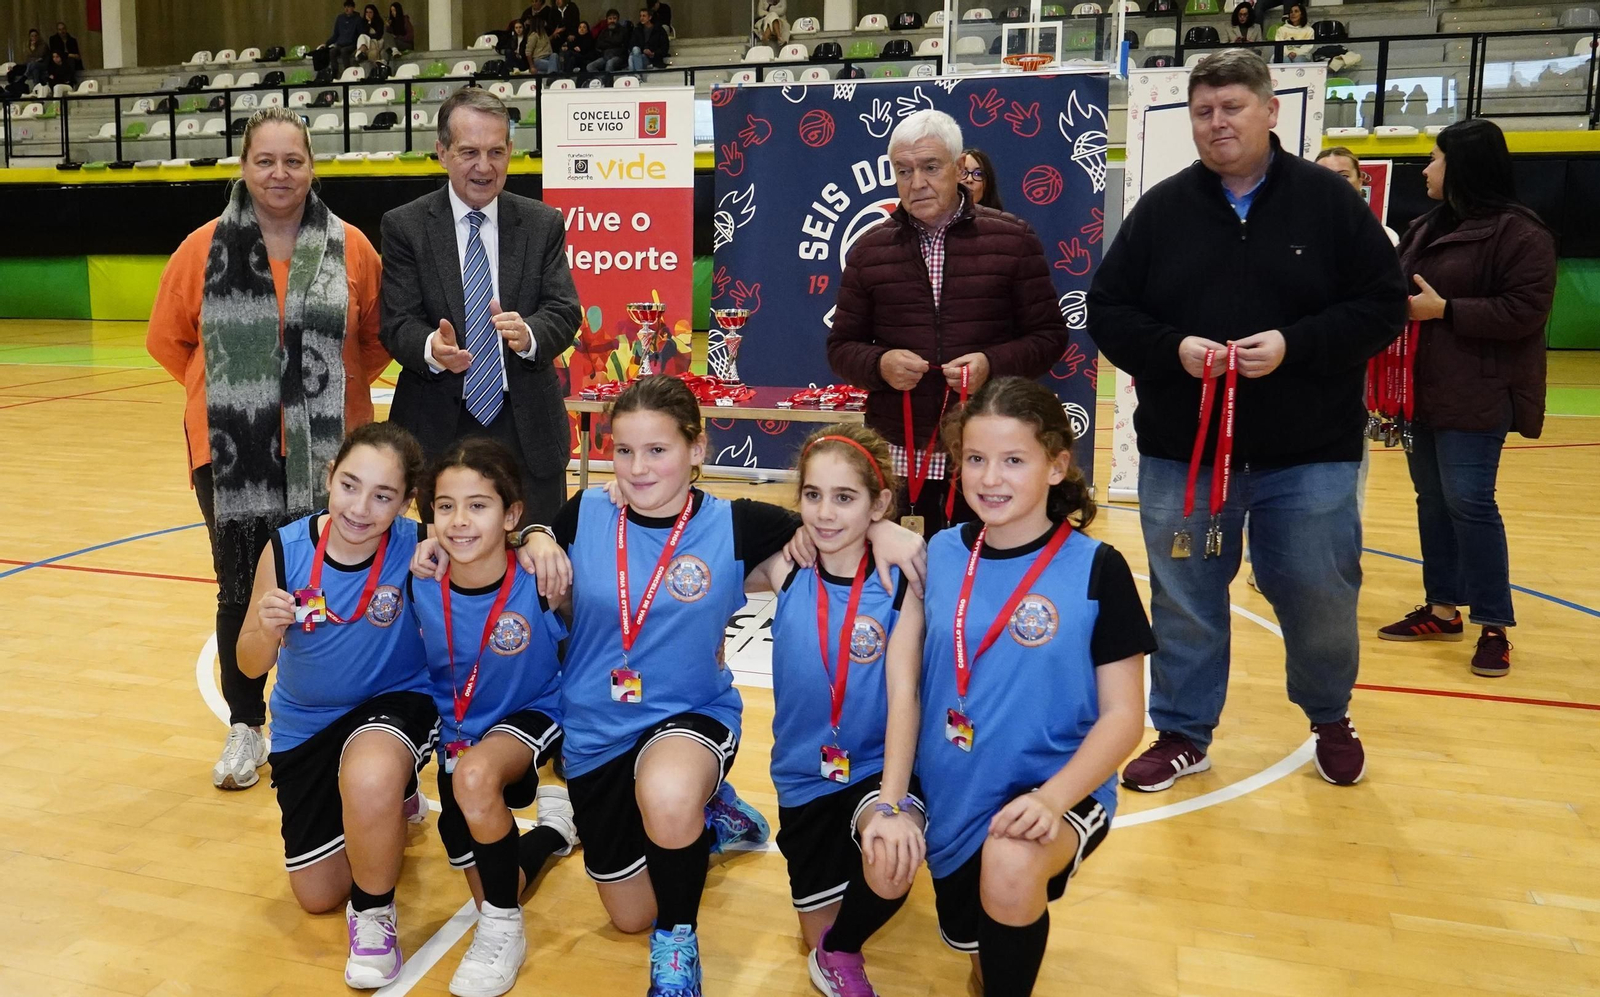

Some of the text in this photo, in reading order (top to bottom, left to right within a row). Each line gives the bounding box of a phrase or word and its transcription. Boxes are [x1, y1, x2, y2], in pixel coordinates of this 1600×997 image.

[573, 111, 630, 121] CONCELLO
[580, 122, 623, 132] DE VIGO
[596, 153, 666, 180] vide
[556, 207, 651, 232] Vive o
[798, 182, 851, 261] SEIS
[808, 275, 830, 295] 19
[1227, 401, 1233, 410] DE
[1224, 467, 1229, 475] DE
[677, 522, 685, 530] DE
[669, 530, 681, 546] VIGO
[967, 540, 981, 576] CONCELLO
[620, 588, 627, 599] DE
[636, 565, 665, 625] CONCELLO DE VIGO
[621, 599, 630, 635] CONCELLO
[955, 598, 966, 669] CONCELLO DE VIGO
[464, 682, 473, 697] VIGO
